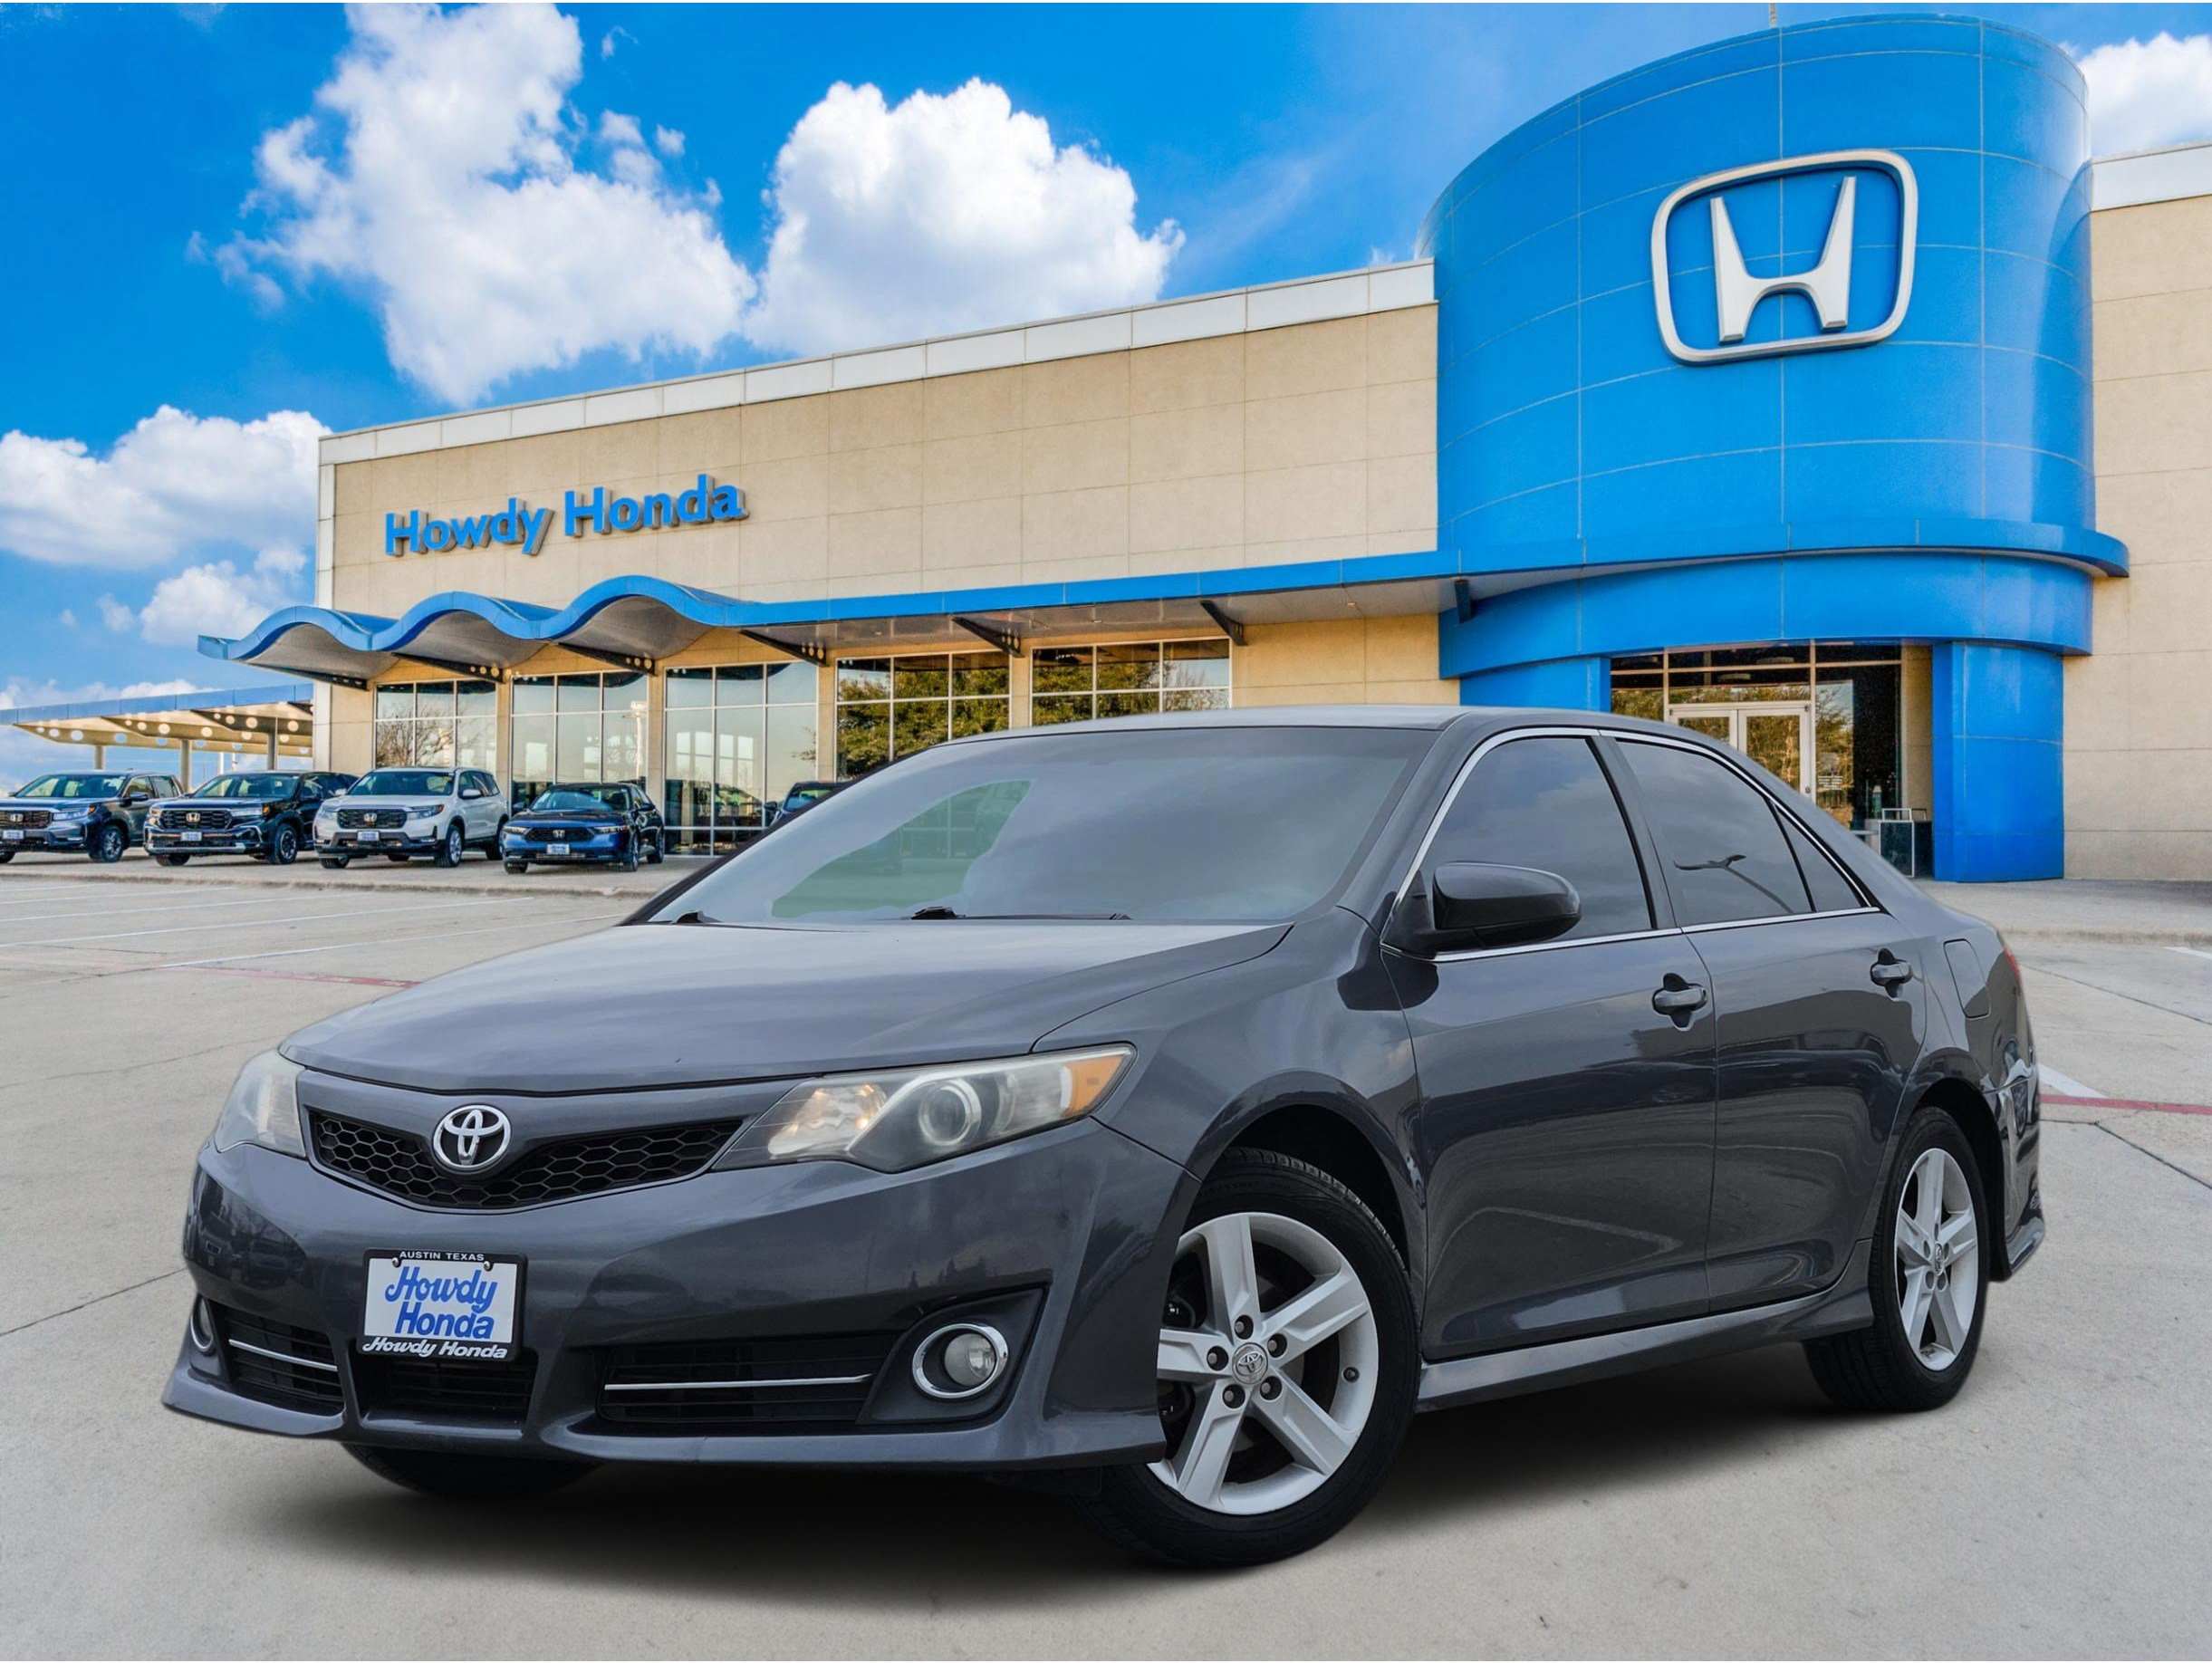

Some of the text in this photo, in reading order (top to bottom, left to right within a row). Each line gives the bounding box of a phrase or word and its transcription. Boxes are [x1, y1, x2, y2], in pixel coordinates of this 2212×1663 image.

[385, 474, 748, 557] Howdy Honda
[399, 1251, 485, 1262] AUSTIN TEXAS
[385, 1266, 498, 1313] Howdy
[394, 1302, 495, 1340] Honda
[362, 1337, 508, 1359] Howdy Honda
